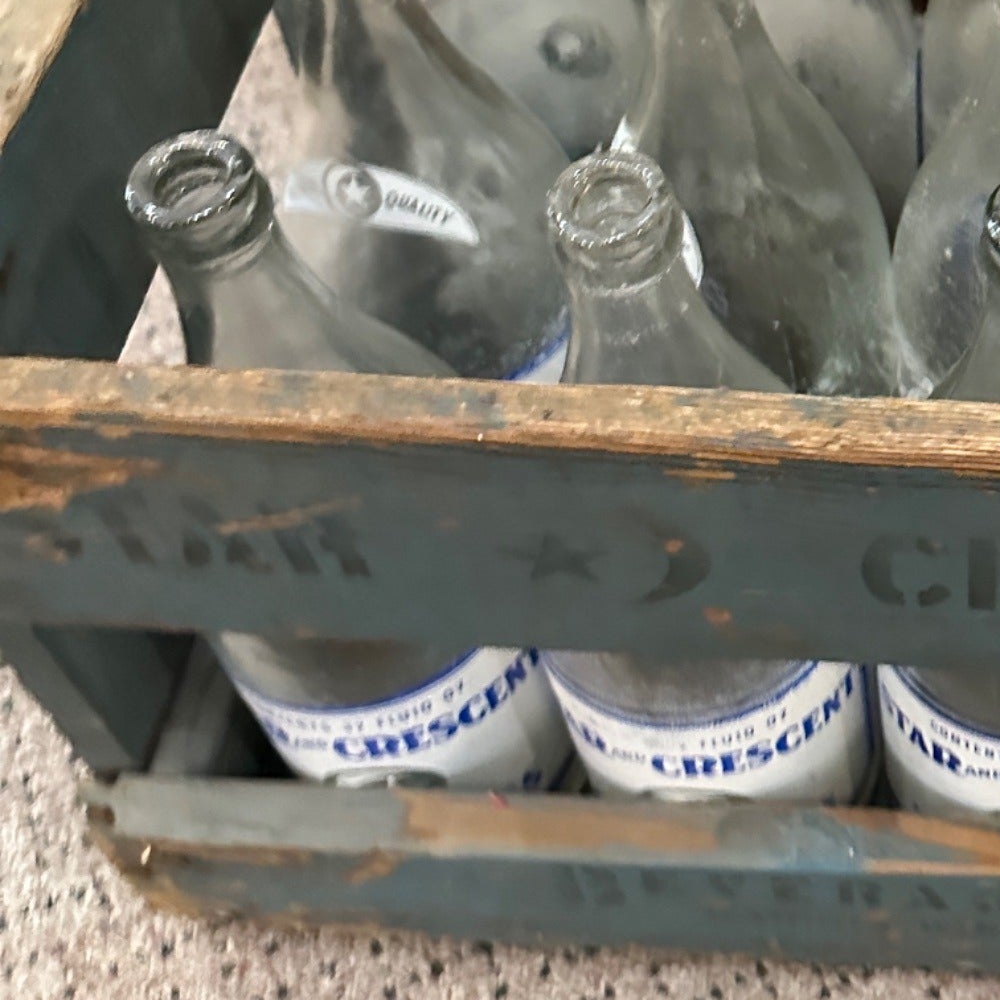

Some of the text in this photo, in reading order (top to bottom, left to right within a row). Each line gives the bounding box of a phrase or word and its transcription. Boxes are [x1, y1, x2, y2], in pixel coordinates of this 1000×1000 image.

[384, 188, 454, 224] QUALITY
[650, 667, 854, 779] CRESCENT
[699, 726, 756, 750] FLUID
